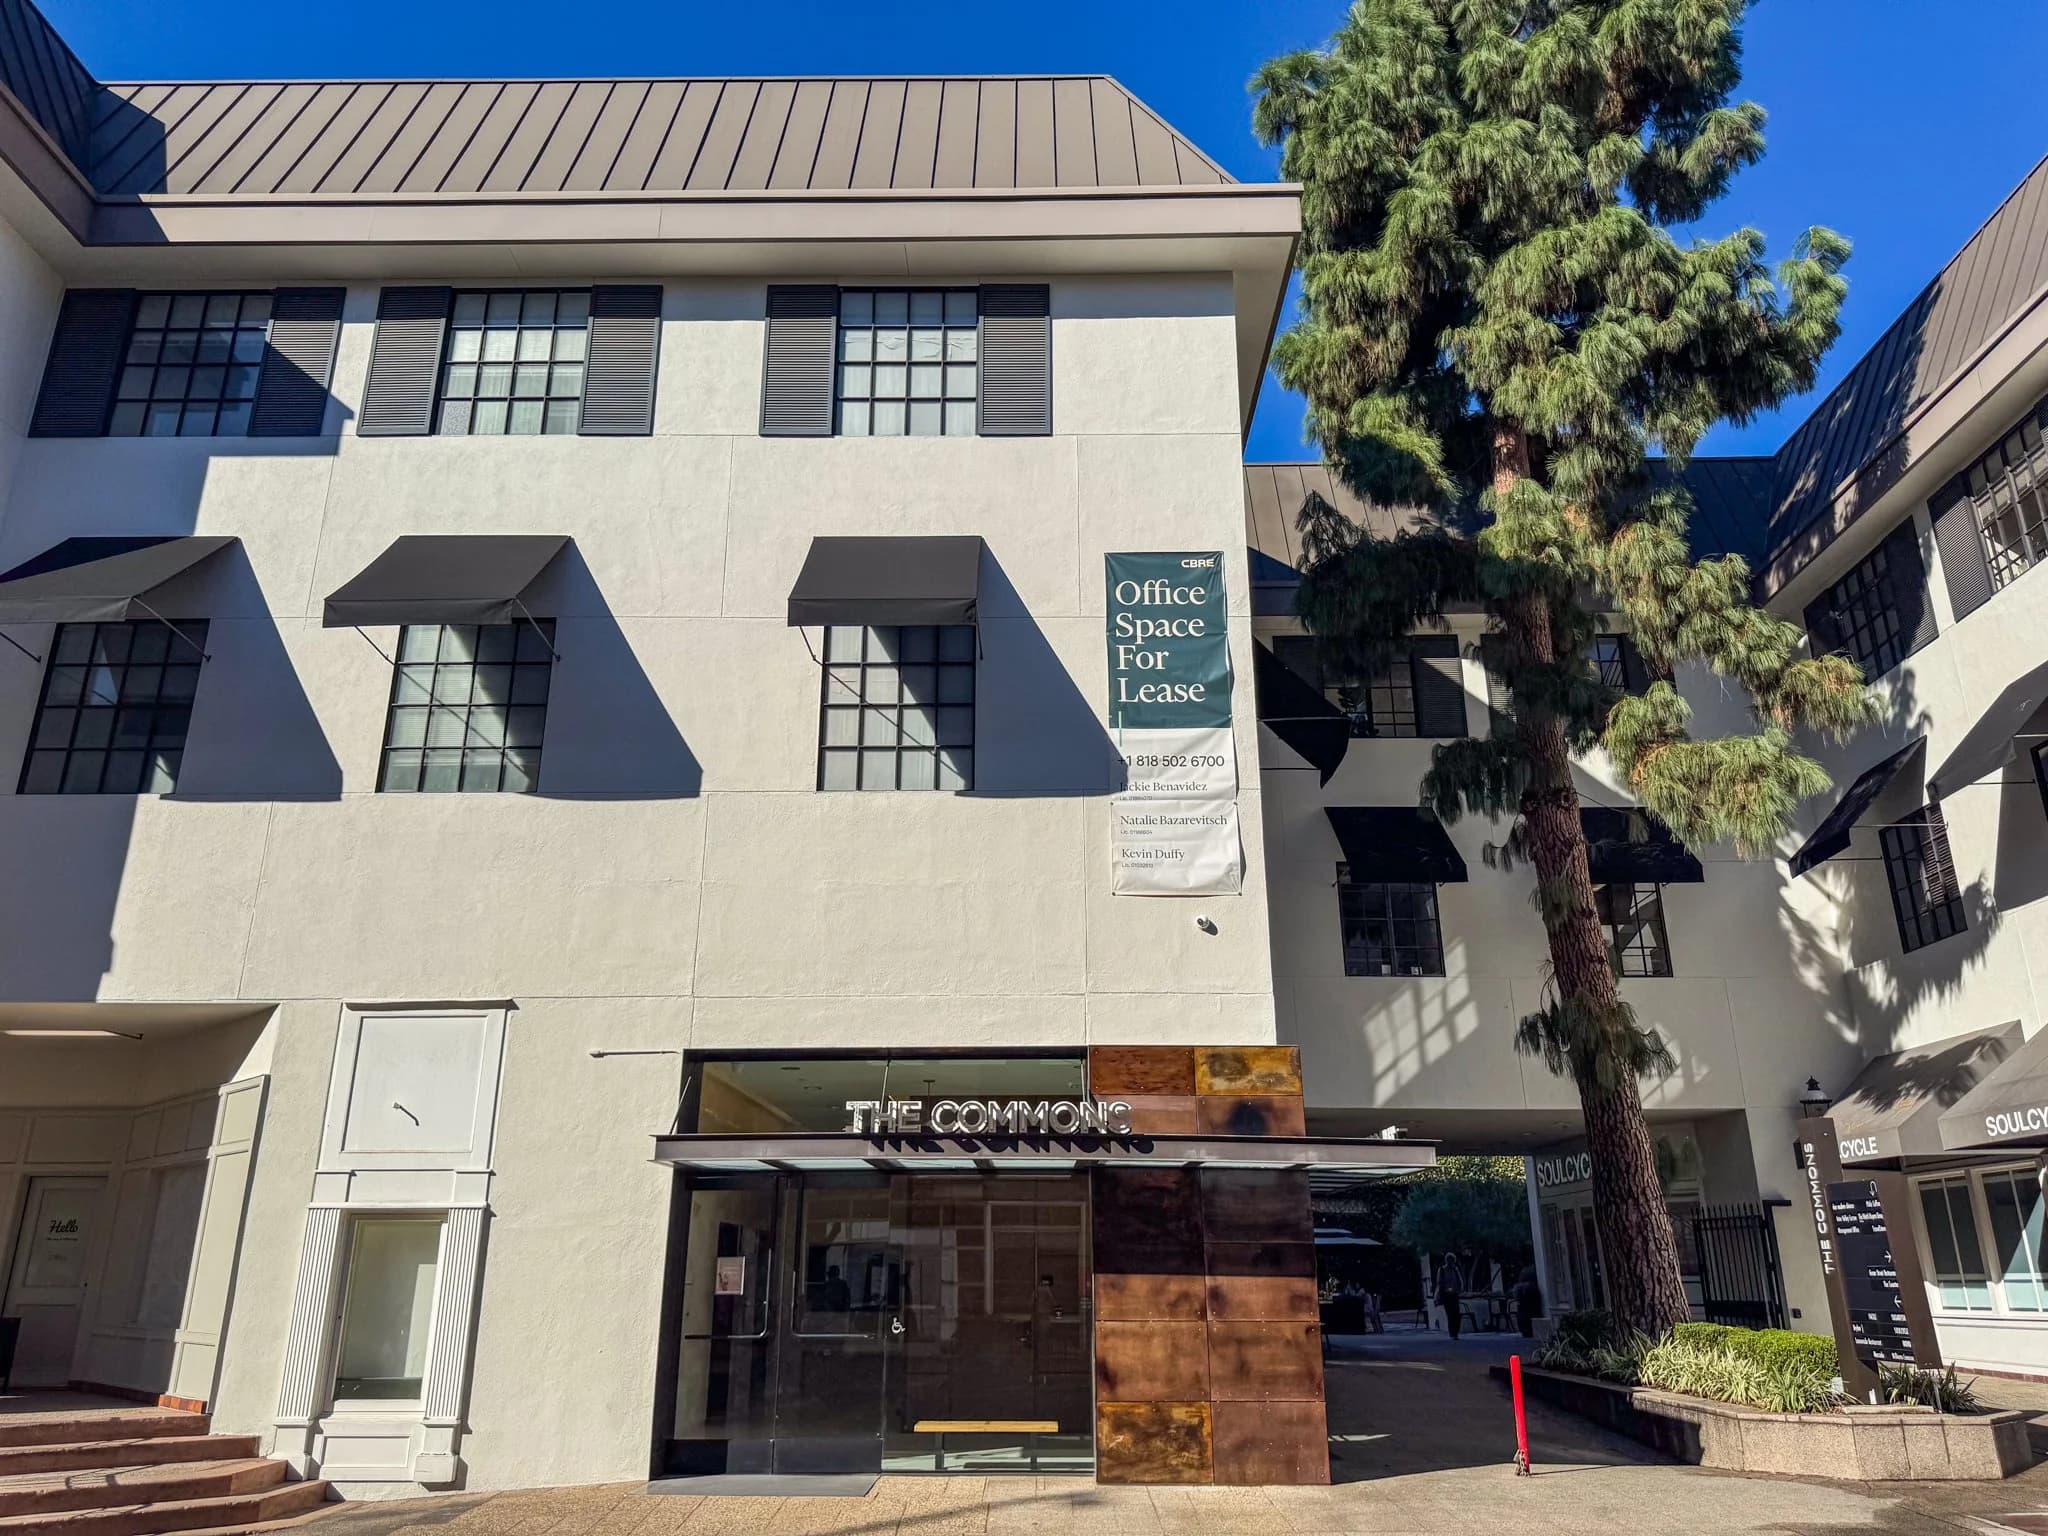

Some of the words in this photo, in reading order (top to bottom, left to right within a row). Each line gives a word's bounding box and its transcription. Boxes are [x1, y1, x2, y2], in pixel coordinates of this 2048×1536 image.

[1181, 559, 1215, 568] CBRE
[1115, 579, 1206, 606] Office
[1115, 613, 1205, 645] Space
[1116, 645, 1169, 670] For
[1117, 677, 1206, 703] Lease
[1117, 755, 1132, 767] +1
[1136, 755, 1159, 767] 818
[1162, 755, 1187, 767] 502
[1191, 755, 1225, 767] 6700
[1120, 781, 1150, 792] Jackie
[1153, 781, 1207, 792] Benavidez
[1120, 815, 1158, 826] Natalie
[1160, 815, 1227, 826] Bazarevitsch
[1122, 848, 1152, 860] Kevin
[1155, 848, 1185, 862] Duffy
[845, 1099, 922, 1134] THE
[930, 1099, 1132, 1135] COMMONS
[1840, 1136, 1879, 1159] CYCLE
[1803, 1142, 1828, 1234] COMMONS
[50, 1219, 79, 1233] Hello
[1820, 1239, 1836, 1274] THE
